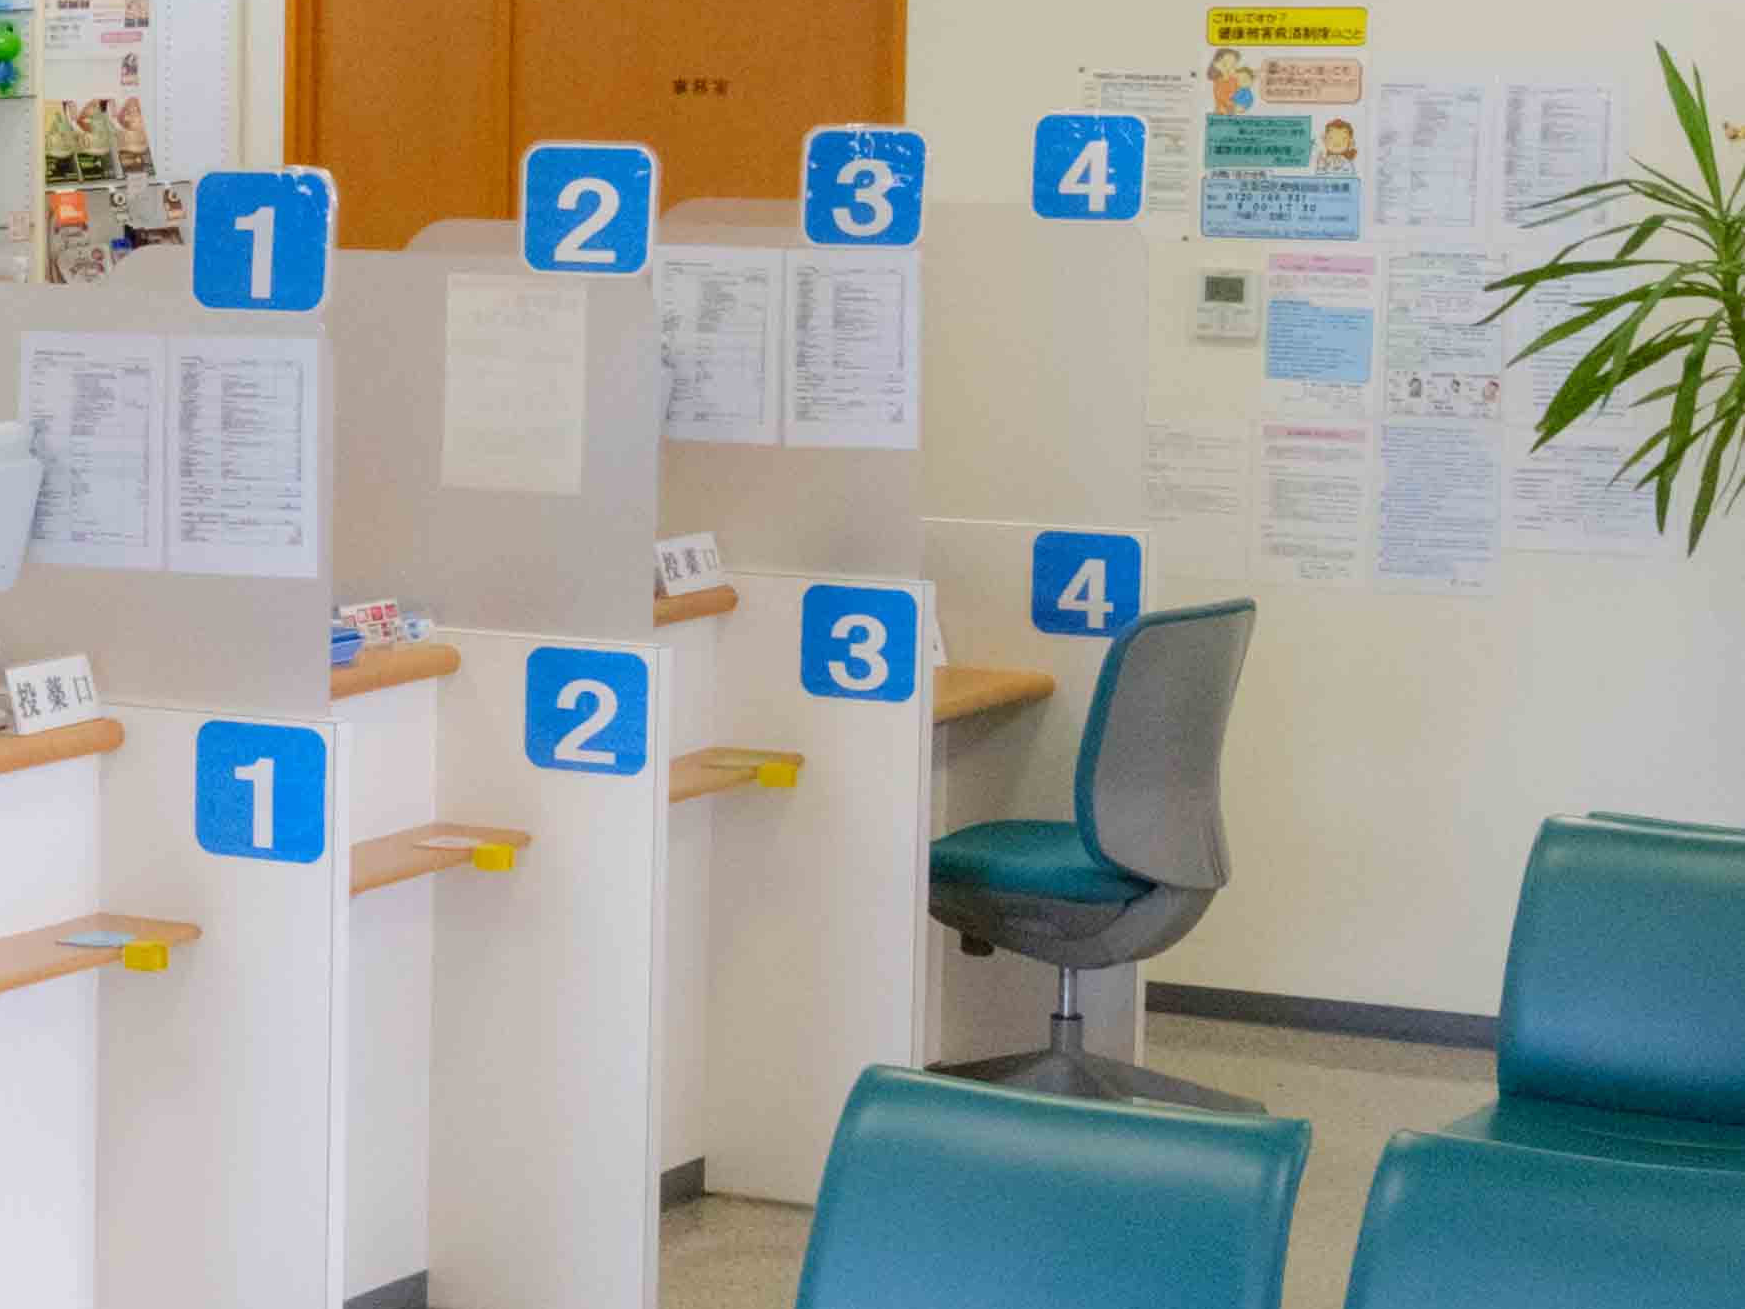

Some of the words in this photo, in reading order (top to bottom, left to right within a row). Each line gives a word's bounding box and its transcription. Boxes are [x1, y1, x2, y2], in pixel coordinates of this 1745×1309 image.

[833, 157, 901, 237] 3
[1059, 139, 1117, 212] 4
[235, 206, 275, 300] 1
[554, 178, 620, 264] 2
[1059, 559, 1114, 629] 4
[828, 615, 890, 692] 3
[554, 679, 618, 766] 2
[234, 757, 275, 850] 1
